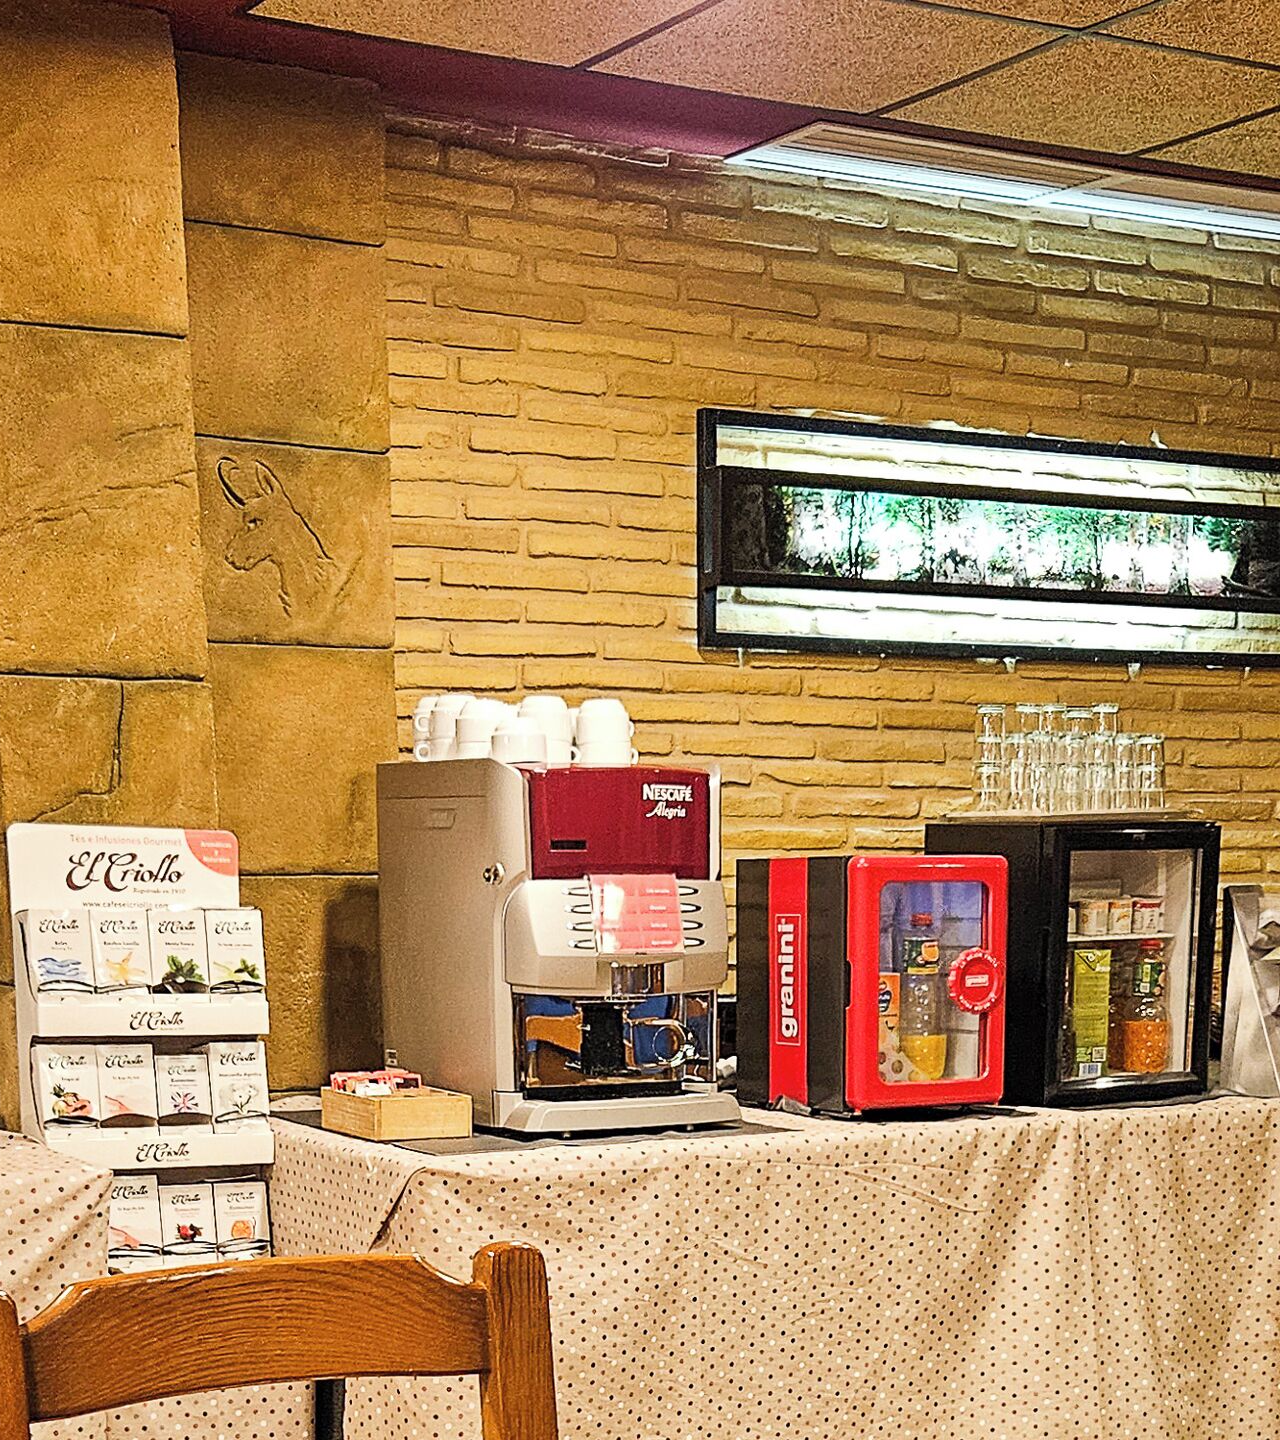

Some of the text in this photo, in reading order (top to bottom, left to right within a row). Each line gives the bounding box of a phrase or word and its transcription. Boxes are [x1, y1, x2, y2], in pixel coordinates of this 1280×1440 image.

[642, 783, 693, 802] NESCAFÉ
[645, 801, 686, 820] Alegria
[66, 850, 186, 893] El Criollo
[778, 922, 799, 1038] granini
[130, 1011, 184, 1030] El Criollo
[136, 1142, 190, 1162] El Criollo
